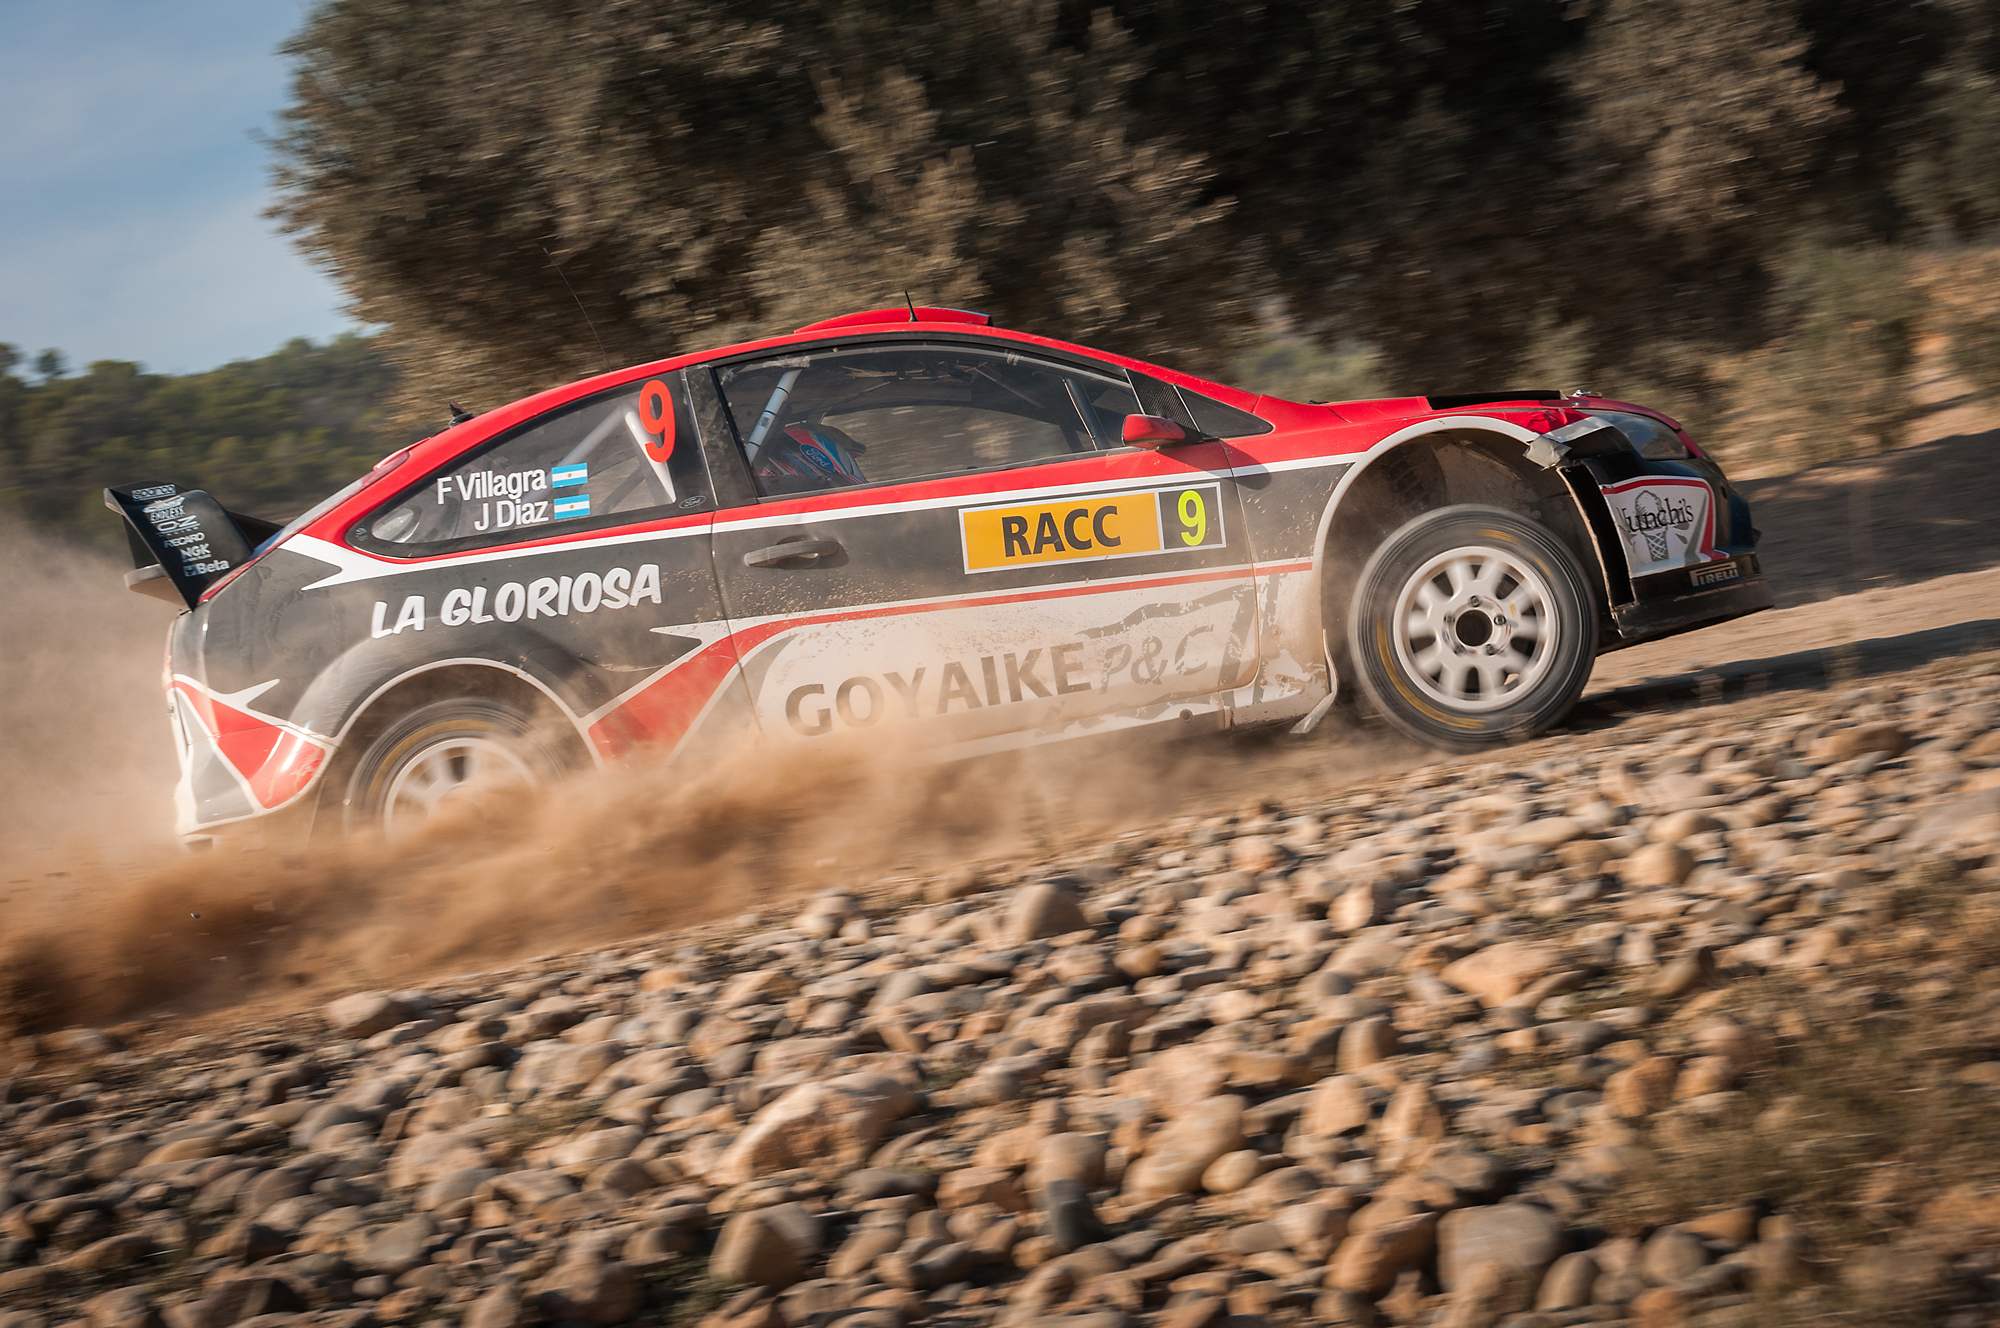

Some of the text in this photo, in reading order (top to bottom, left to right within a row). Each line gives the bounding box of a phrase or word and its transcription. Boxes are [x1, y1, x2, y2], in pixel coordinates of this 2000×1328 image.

[639, 379, 676, 463] 9
[805, 447, 830, 468] Ford
[437, 469, 547, 505] F Villagra
[474, 499, 549, 531] J Diaz
[1001, 505, 1121, 558] RACC
[1177, 490, 1206, 546] 9
[164, 532, 206, 548] RECARO
[180, 543, 212, 558] NGK
[195, 560, 230, 574] Beta
[1689, 561, 1740, 587] PIRELLI
[371, 564, 662, 639] LA GLORIOSA
[785, 641, 1092, 737] GOYAIKE
